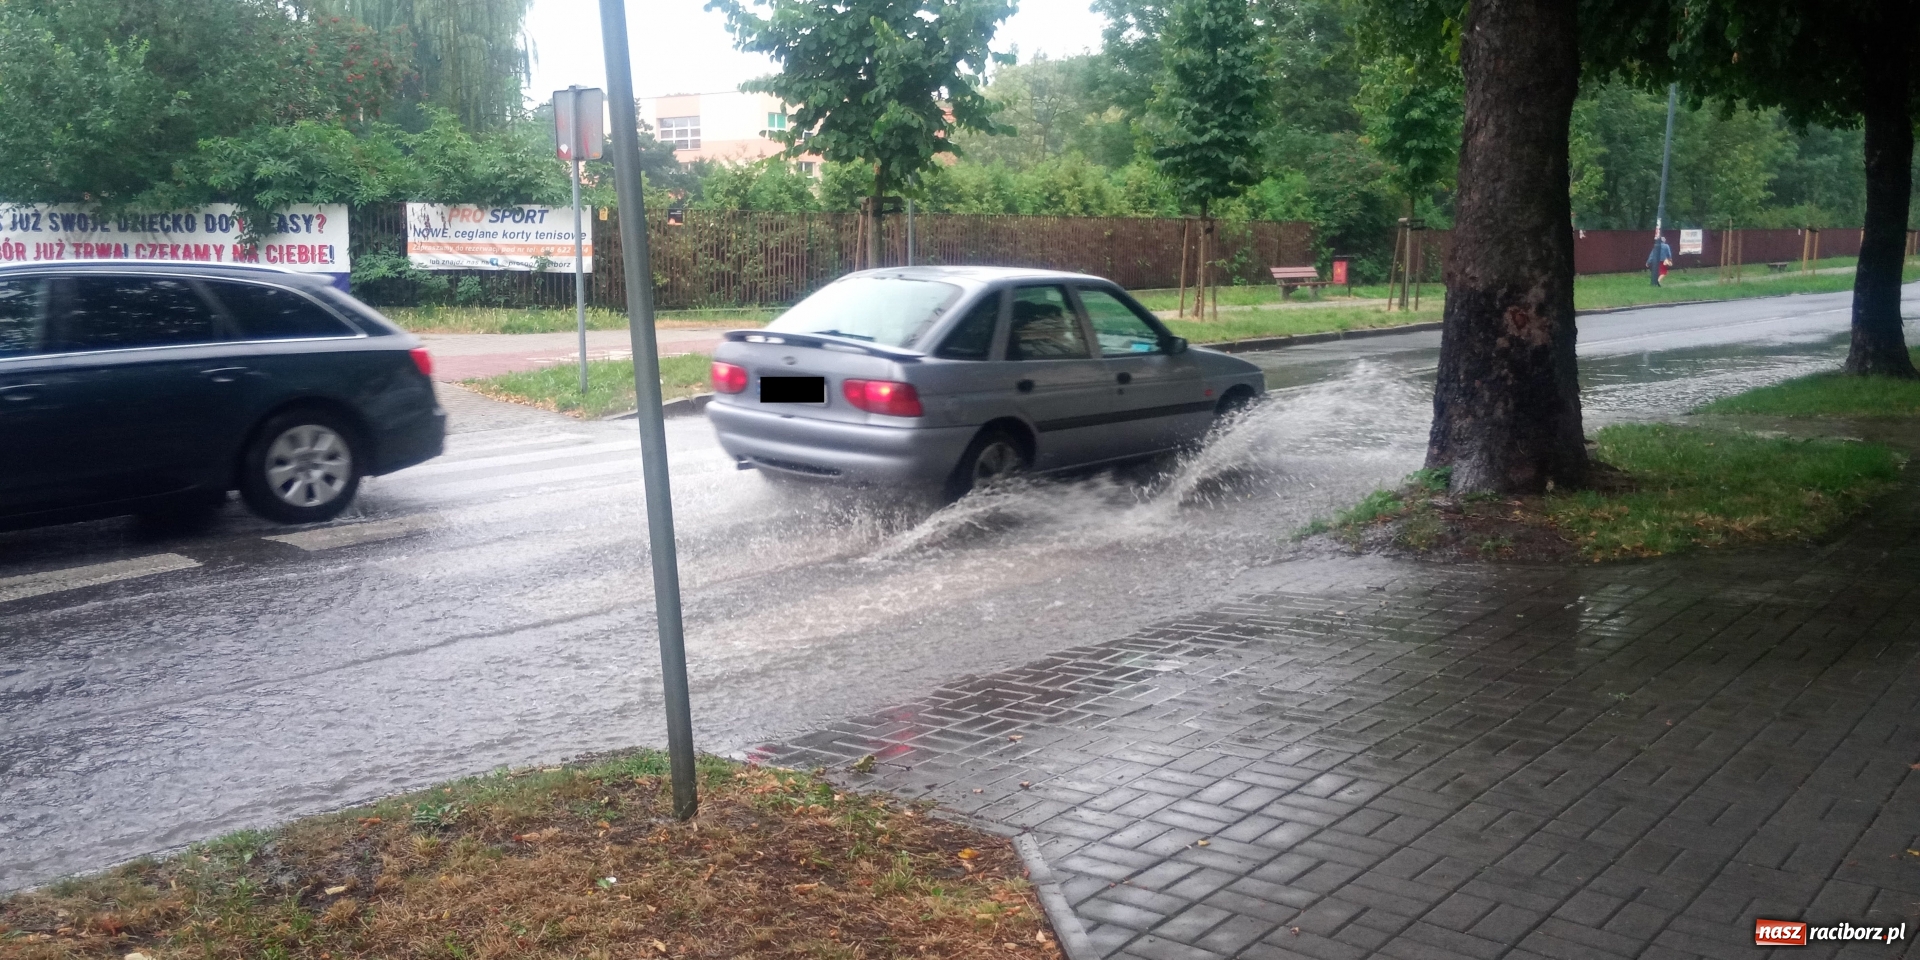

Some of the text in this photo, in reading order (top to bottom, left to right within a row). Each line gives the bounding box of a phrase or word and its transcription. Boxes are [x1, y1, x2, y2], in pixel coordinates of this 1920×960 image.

[10, 209, 42, 232] JUŻ
[49, 213, 110, 232] SWOJE
[118, 213, 197, 233] DZIECKO
[204, 213, 230, 233] DO
[448, 208, 549, 224] PRO SPORT
[454, 229, 498, 241] ceglane
[502, 229, 532, 242] korty
[0, 237, 335, 264] ÓR JUŻ TRWA! CZEKAMY NA CIEBIE!
